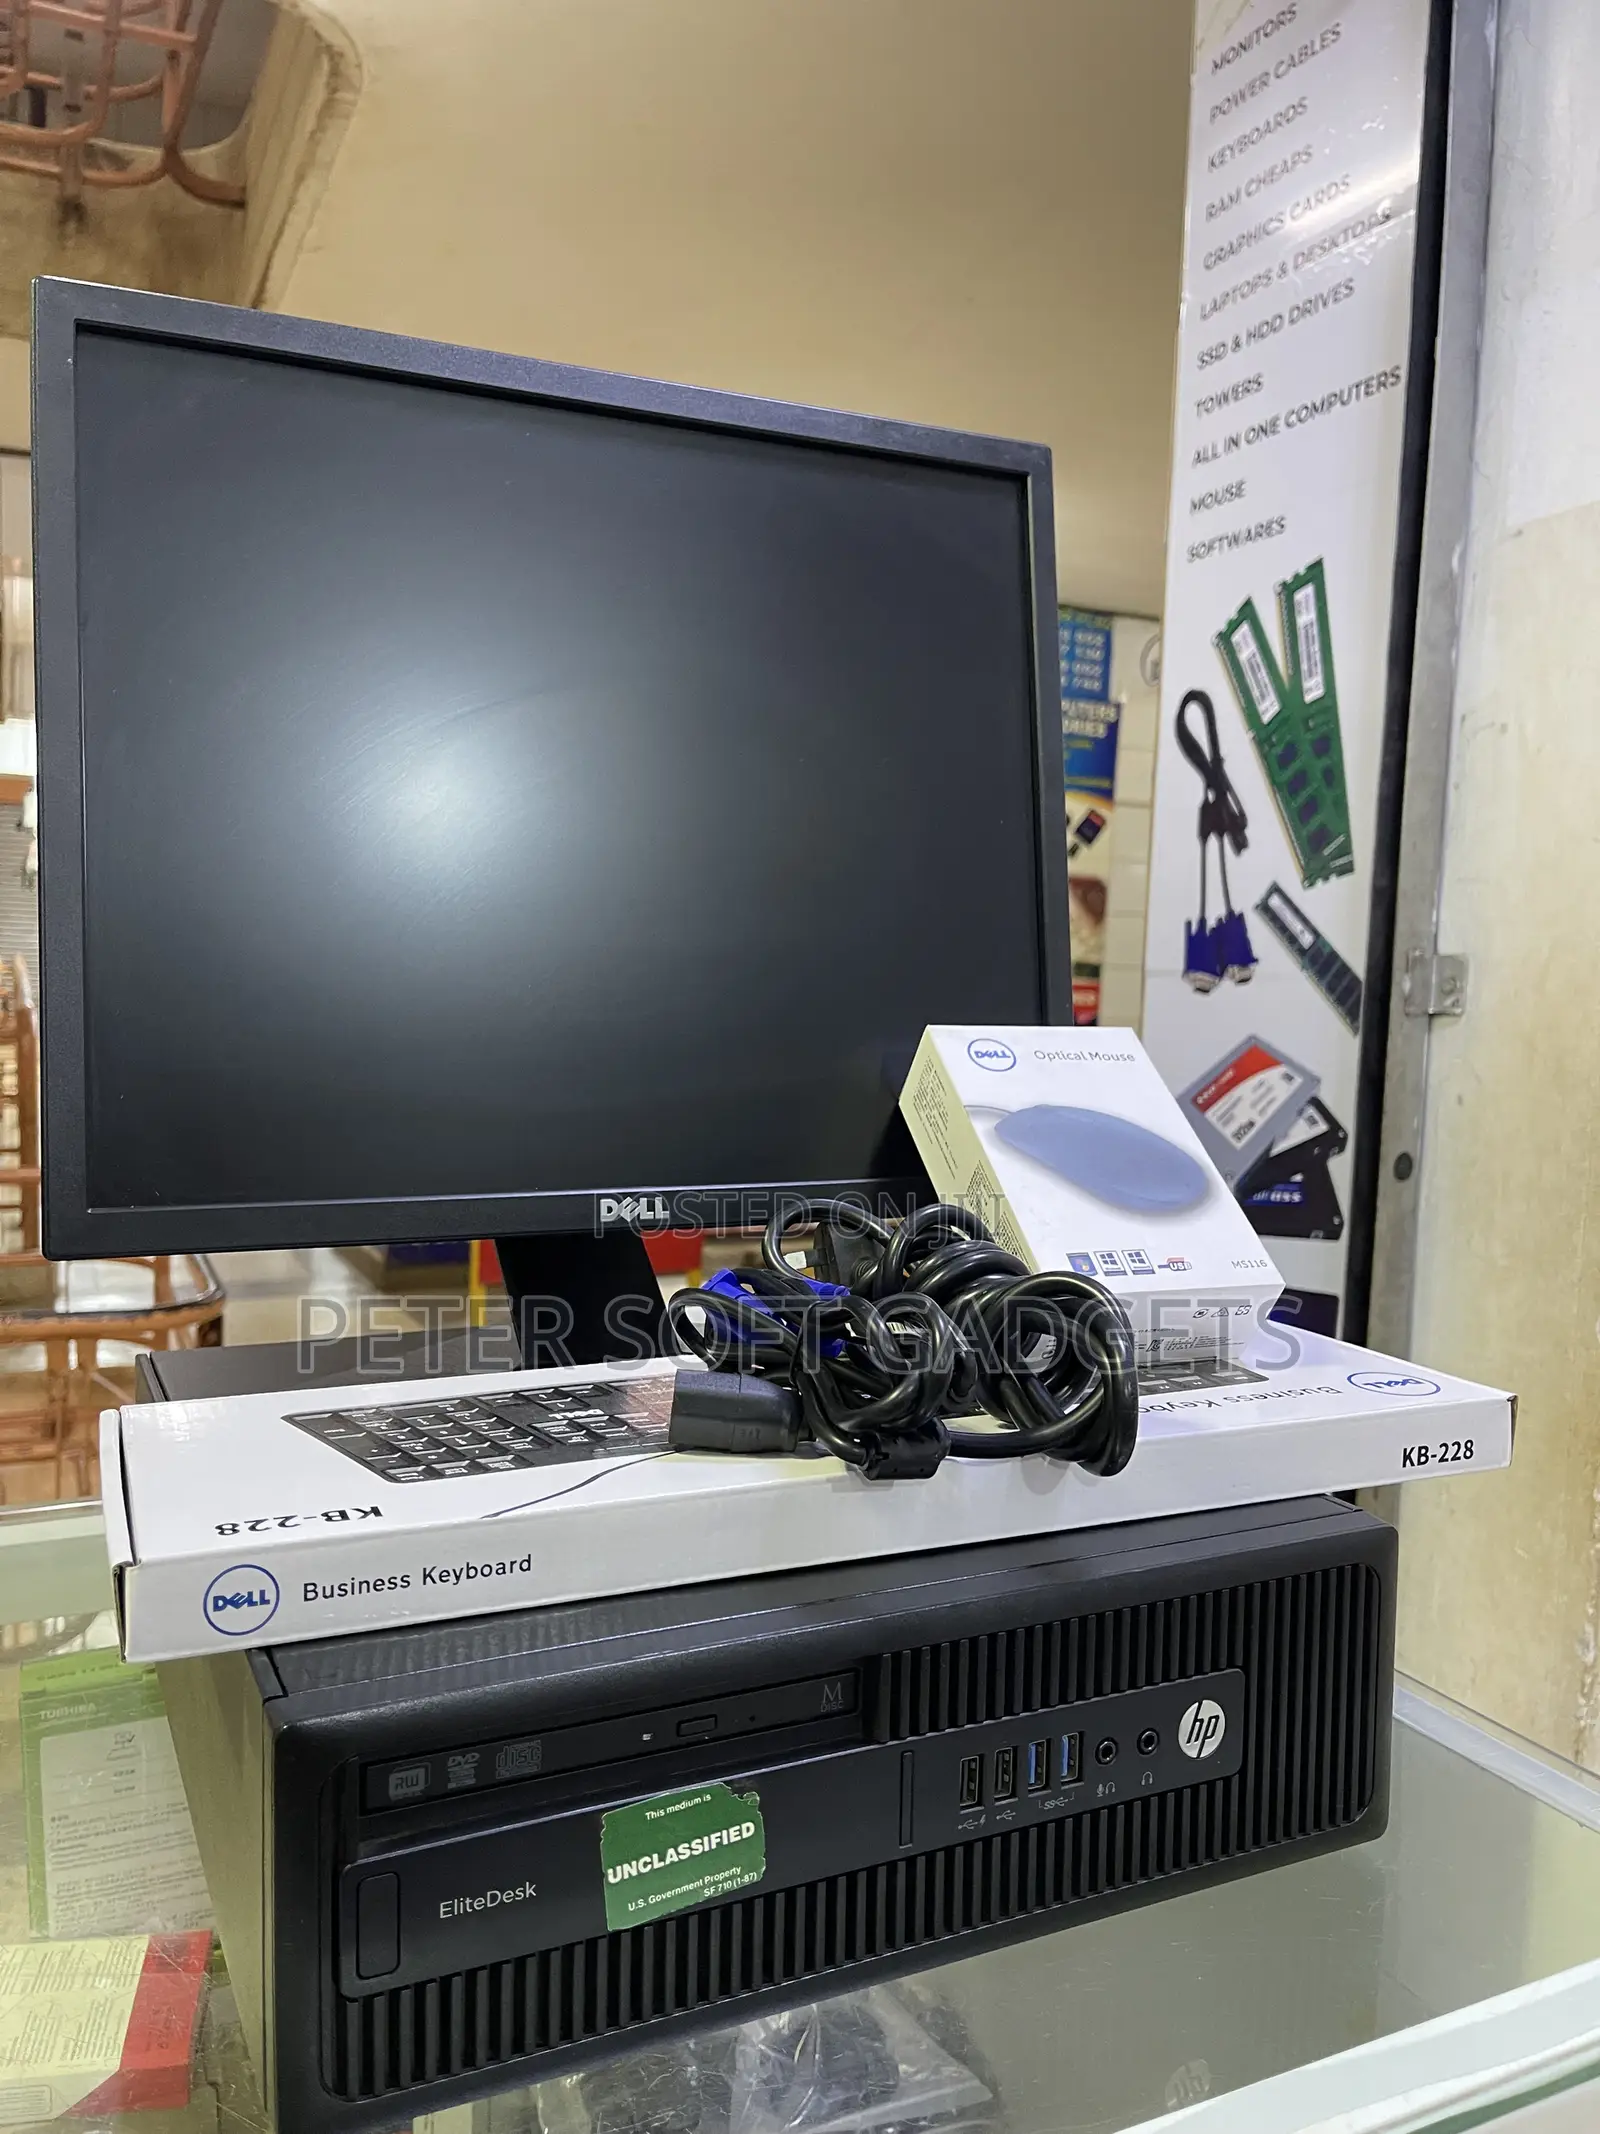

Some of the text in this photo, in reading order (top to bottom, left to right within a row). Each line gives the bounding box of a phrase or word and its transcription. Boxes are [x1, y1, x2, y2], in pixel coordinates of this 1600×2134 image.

[1211, 3, 1298, 75] MONITORS
[1209, 22, 1342, 124] POWER CABLES
[1207, 96, 1308, 173] KEYBOARDS
[1205, 144, 1313, 222] RAM CHEAPS
[1203, 174, 1350, 271] GRAPHICS CARDS
[1200, 267, 1274, 321] LAPTOPS
[1276, 261, 1288, 279] &
[1197, 277, 1355, 370] SSD & HDD DRIVES
[1195, 373, 1264, 418] TOWERS
[1191, 365, 1401, 468] ALL IN ONE COMPUTERS
[1189, 479, 1247, 514] MOUSE
[1187, 515, 1287, 563] SOFTWARES
[974, 1050, 1011, 1059] DELL
[1033, 1050, 1136, 1063] Optical Mouse
[600, 1196, 670, 1223] DELL
[1169, 1261, 1192, 1272] USB
[1231, 1259, 1268, 1269] MS116
[1223, 1386, 1344, 1405] Business
[1364, 1378, 1426, 1390] DELL
[1402, 1439, 1475, 1469] KB-228
[215, 1504, 384, 1537] KB-228
[303, 1553, 532, 1603] Business Keyboard
[213, 1589, 270, 1613] DELL
[1184, 1699, 1221, 1760] hp
[447, 1752, 481, 1767] DVD
[394, 1773, 420, 1792] RW
[645, 1793, 712, 1821] This medium is
[607, 1821, 756, 1884] UNCLASSIFIED
[440, 1881, 537, 1919] EliteDesk
[628, 1865, 742, 1912] U.S. Government Property
[703, 1871, 758, 1897] SF 710 (1-87)
